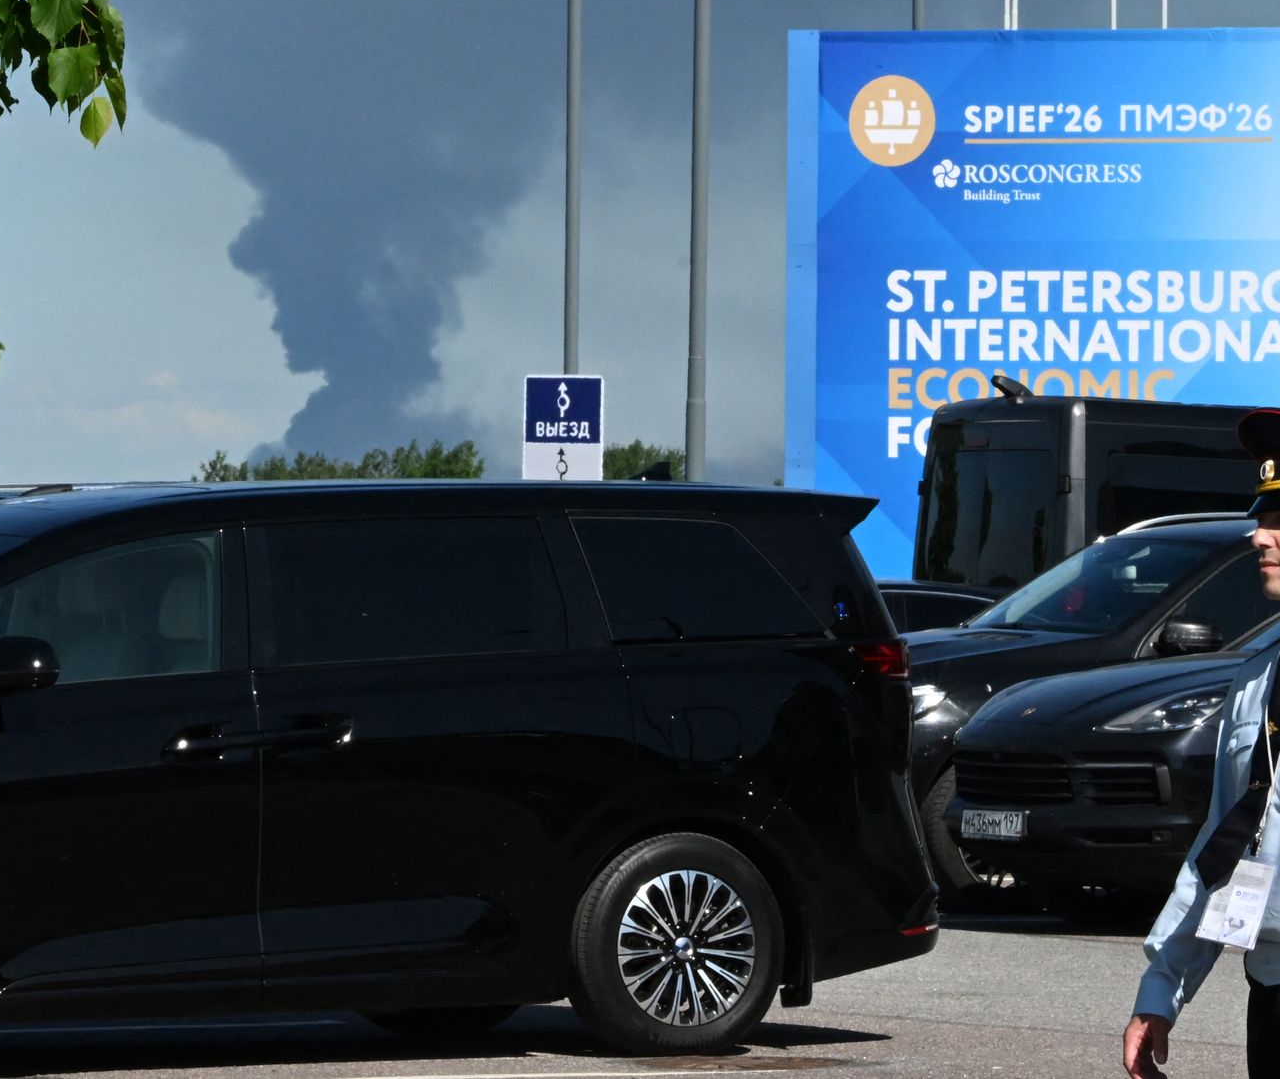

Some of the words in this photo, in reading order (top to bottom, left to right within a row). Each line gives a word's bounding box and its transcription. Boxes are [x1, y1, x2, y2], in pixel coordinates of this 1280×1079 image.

[964, 164, 1142, 184] ROSCONGRESS
[964, 190, 1010, 204] Building
[1012, 190, 1041, 202] Trust
[886, 269, 954, 313] ST.
[536, 421, 590, 439] ВЫЕЗД
